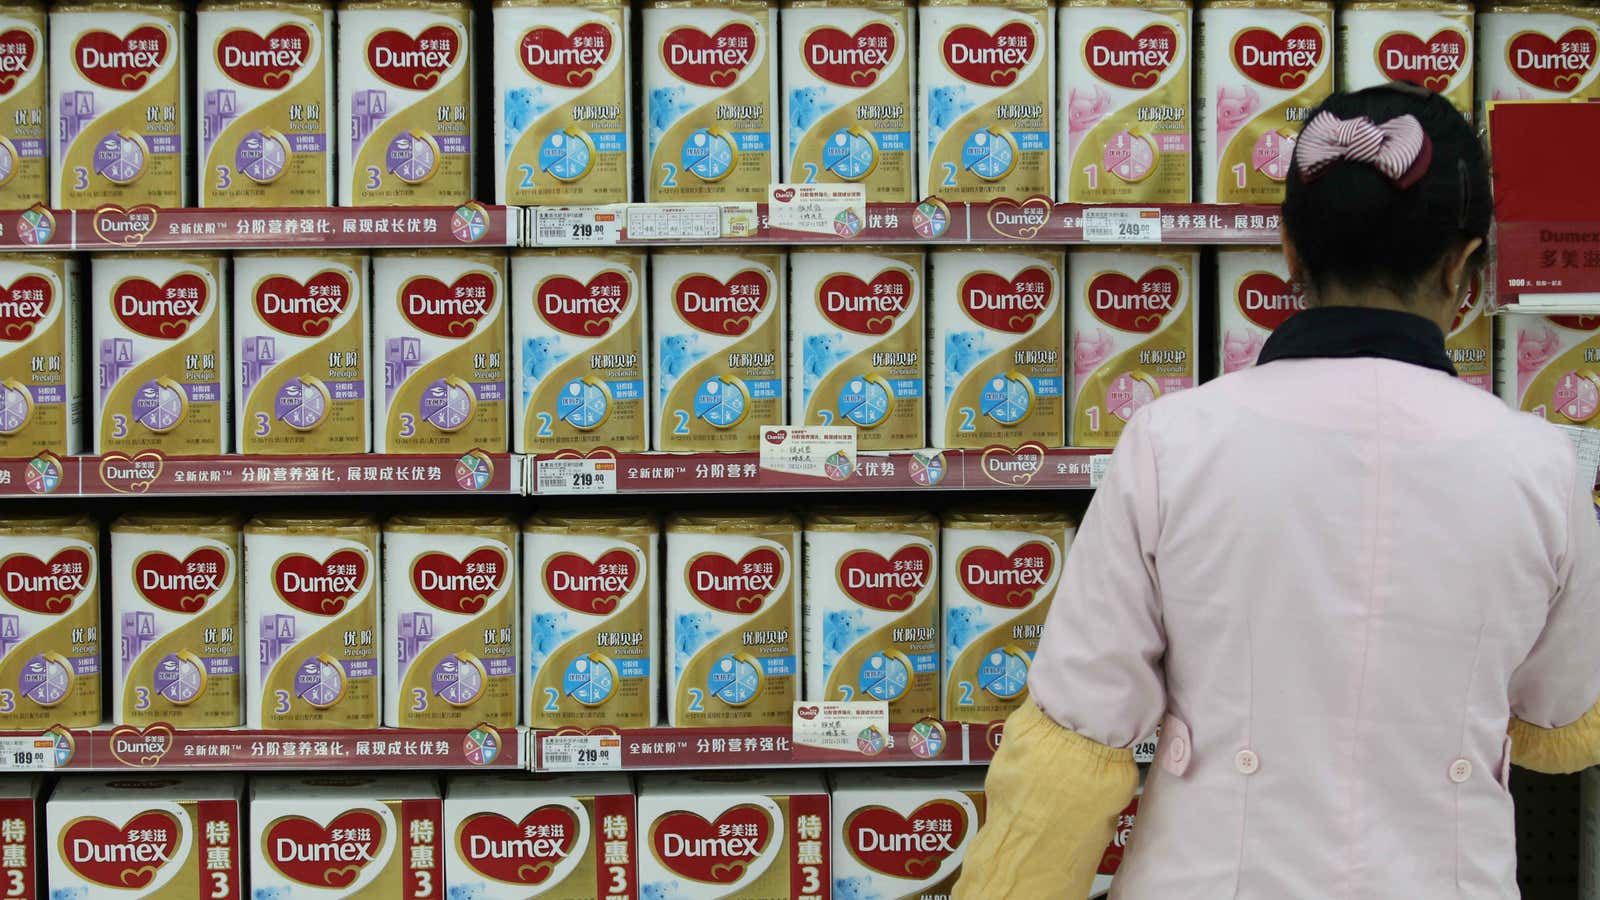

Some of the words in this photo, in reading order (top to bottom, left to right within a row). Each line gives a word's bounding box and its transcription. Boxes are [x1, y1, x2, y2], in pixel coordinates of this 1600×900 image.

[127, 39, 160, 51] 多美滋
[270, 38, 302, 50] 多美滋
[418, 39, 451, 51] 多美滋
[572, 36, 605, 48] 多美滋
[716, 36, 749, 48] 多美滋
[856, 36, 889, 48] 多美滋
[997, 36, 1028, 47] 多美滋
[1138, 38, 1169, 49] 多美滋
[1286, 39, 1317, 50] 多美滋
[1430, 43, 1461, 54] 多美滋
[1560, 42, 1591, 53] 多美滋
[82, 47, 161, 68] Dumex
[224, 46, 303, 67] Dumex
[375, 47, 452, 67] Dumex
[528, 44, 607, 65] Dumex
[671, 44, 750, 65] Dumex
[812, 44, 891, 65] Dumex
[951, 43, 1030, 64] Dumex
[1093, 45, 1172, 66] Dumex
[1242, 46, 1318, 66] Dumex
[1386, 50, 1461, 70] Dumex
[1517, 50, 1592, 70] Dumex
[74, 167, 89, 190] 3
[217, 166, 232, 189] 3
[367, 167, 382, 190] 3
[518, 163, 535, 189] 2
[661, 162, 678, 188] 2
[941, 161, 958, 187] 2
[1084, 163, 1098, 189] 1
[1232, 163, 1246, 189] 1
[101, 218, 151, 233] Dumex
[996, 213, 1044, 226] Dumex
[1540, 229, 1600, 242] Dumex
[11, 289, 44, 301] 多美滋
[166, 287, 199, 299] 多美滋
[309, 285, 342, 297] 多美滋
[454, 286, 487, 298] 多美滋
[589, 285, 622, 297] 多美滋
[730, 284, 761, 295] 多美滋
[872, 283, 905, 295] 多美滋
[1015, 282, 1046, 293] 多美滋
[1142, 282, 1173, 293] 多美滋
[121, 295, 200, 316] Dumex
[264, 293, 343, 314] Dumex
[409, 294, 488, 315] Dumex
[545, 293, 624, 314] Dumex
[684, 292, 763, 313] Dumex
[828, 291, 907, 312] Dumex
[970, 289, 1049, 310] Dumex
[1096, 289, 1175, 310] Dumex
[113, 415, 128, 438] 3
[256, 413, 271, 436] 3
[400, 414, 415, 437] 3
[536, 411, 553, 437] 2
[673, 409, 690, 435] 2
[959, 406, 976, 432] 2
[1086, 405, 1100, 431] 1
[107, 466, 154, 480] Dumex
[989, 458, 1037, 472] Dumex
[52, 563, 83, 574] 多美滋
[186, 562, 217, 573] 多美滋
[326, 564, 357, 575] 多美滋
[465, 562, 498, 574] 多美滋
[598, 564, 629, 575] 多美滋
[742, 562, 775, 574] 多美滋
[893, 560, 924, 571] 多美滋
[1014, 557, 1045, 568] 多美滋
[7, 571, 86, 592] Dumex
[143, 570, 220, 590] Dumex
[283, 572, 359, 592] Dumex
[420, 570, 499, 591] Dumex
[553, 571, 632, 592] Dumex
[697, 570, 776, 591] Dumex
[848, 567, 927, 588] Dumex
[968, 564, 1047, 585] Dumex
[0, 690, 15, 713] 3
[136, 687, 151, 710] 3
[276, 691, 291, 714] 3
[413, 689, 428, 712] 3
[543, 686, 560, 712] 2
[687, 686, 704, 712] 2
[957, 680, 974, 706] 2
[117, 740, 165, 753] Dumex
[127, 829, 168, 842] 多美滋
[331, 828, 372, 841] 多美滋
[524, 825, 565, 838] 多美滋
[718, 824, 759, 837] 多美滋
[912, 819, 953, 832] 多美滋
[73, 838, 169, 863] Dumex
[277, 837, 373, 862] Dumex
[470, 834, 566, 859] Dumex
[664, 833, 760, 858] Dumex
[858, 828, 954, 853] Dumex
[604, 814, 628, 900] 特惠3
[797, 814, 822, 900] 特惠3
